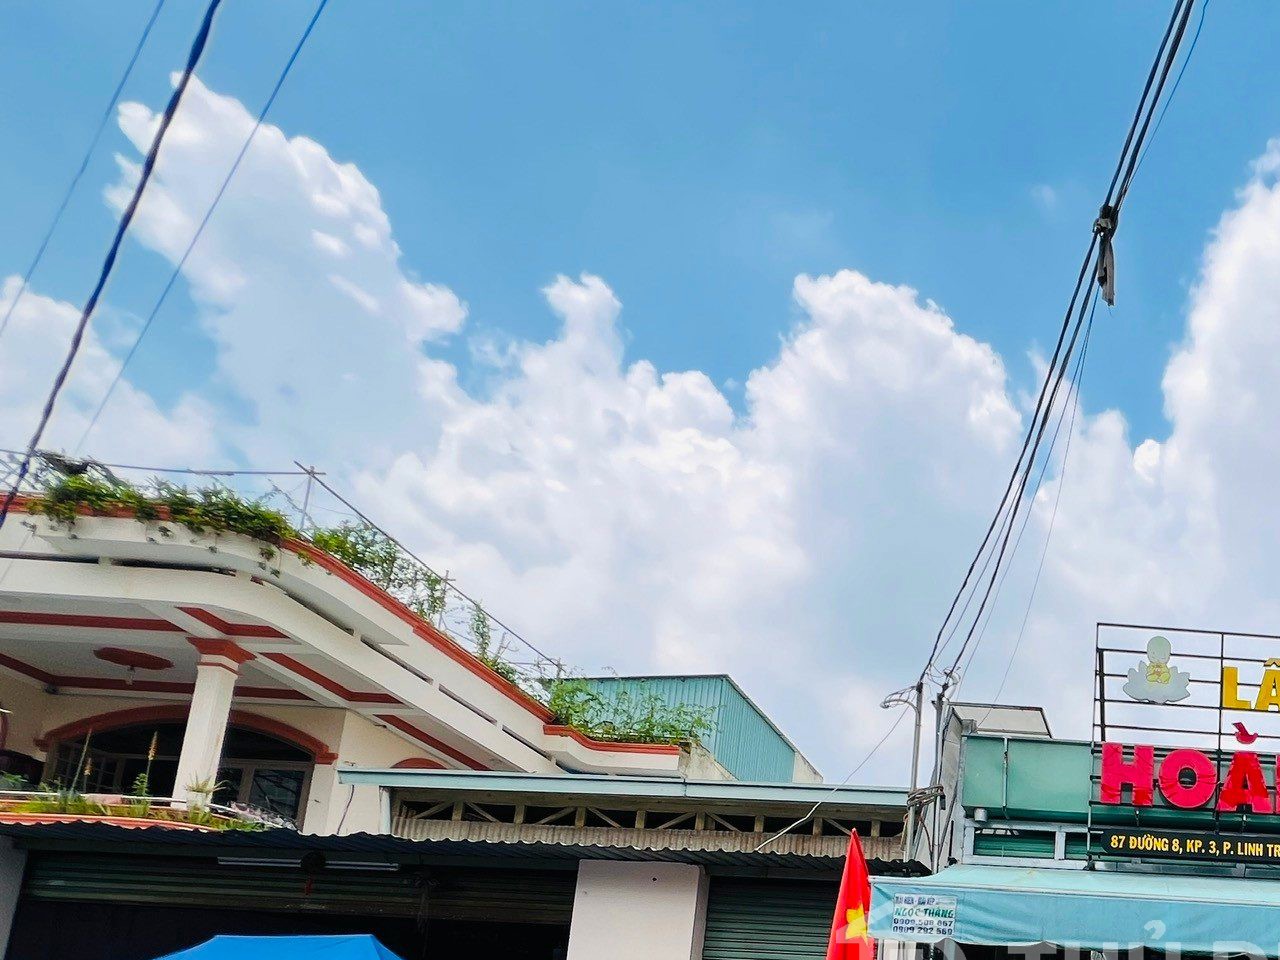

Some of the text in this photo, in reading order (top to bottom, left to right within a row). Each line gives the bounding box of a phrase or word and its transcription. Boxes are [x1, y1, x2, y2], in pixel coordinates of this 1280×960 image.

[1110, 835, 1125, 848] 87
[1129, 834, 1168, 851] ĐƯỜNG
[1172, 839, 1183, 855] 8,
[1187, 839, 1205, 854] KP.
[1208, 841, 1220, 856] 3,
[1223, 842, 1234, 855] P.
[1237, 842, 1263, 858] LINH
